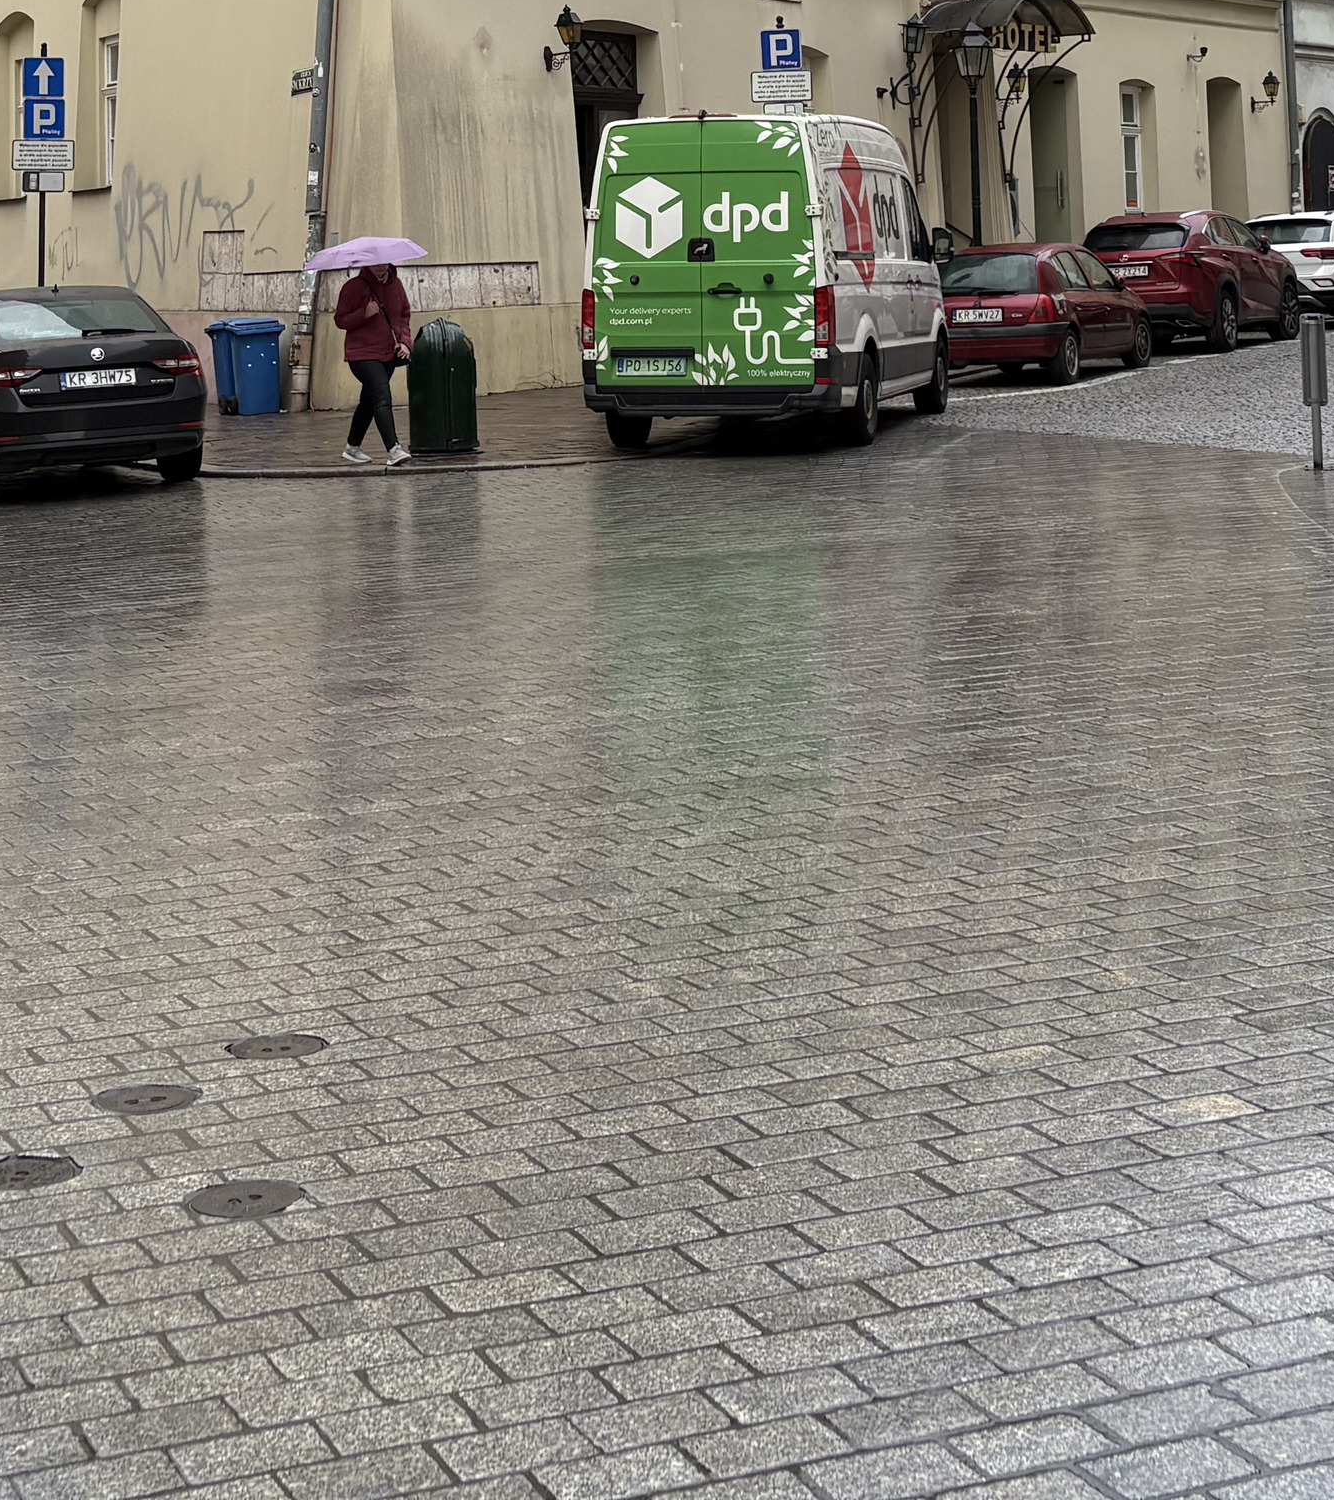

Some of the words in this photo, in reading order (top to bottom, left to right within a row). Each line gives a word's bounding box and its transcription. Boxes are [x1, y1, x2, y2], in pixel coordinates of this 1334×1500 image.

[991, 21, 1057, 53] HOTEL
[769, 33, 793, 66] P
[33, 103, 56, 134] P
[703, 191, 789, 243] dpd
[873, 174, 900, 256] dpd
[610, 307, 628, 315] Your
[629, 307, 661, 316] delivery
[661, 307, 692, 315] experts
[958, 311, 970, 321] KR
[610, 318, 653, 326] dpd.com.pl
[647, 360, 682, 372] 1SJ56
[747, 369, 768, 377] 100%
[769, 369, 812, 378] elektryczny
[69, 372, 87, 386] KR
[93, 369, 133, 385] 3HW75
